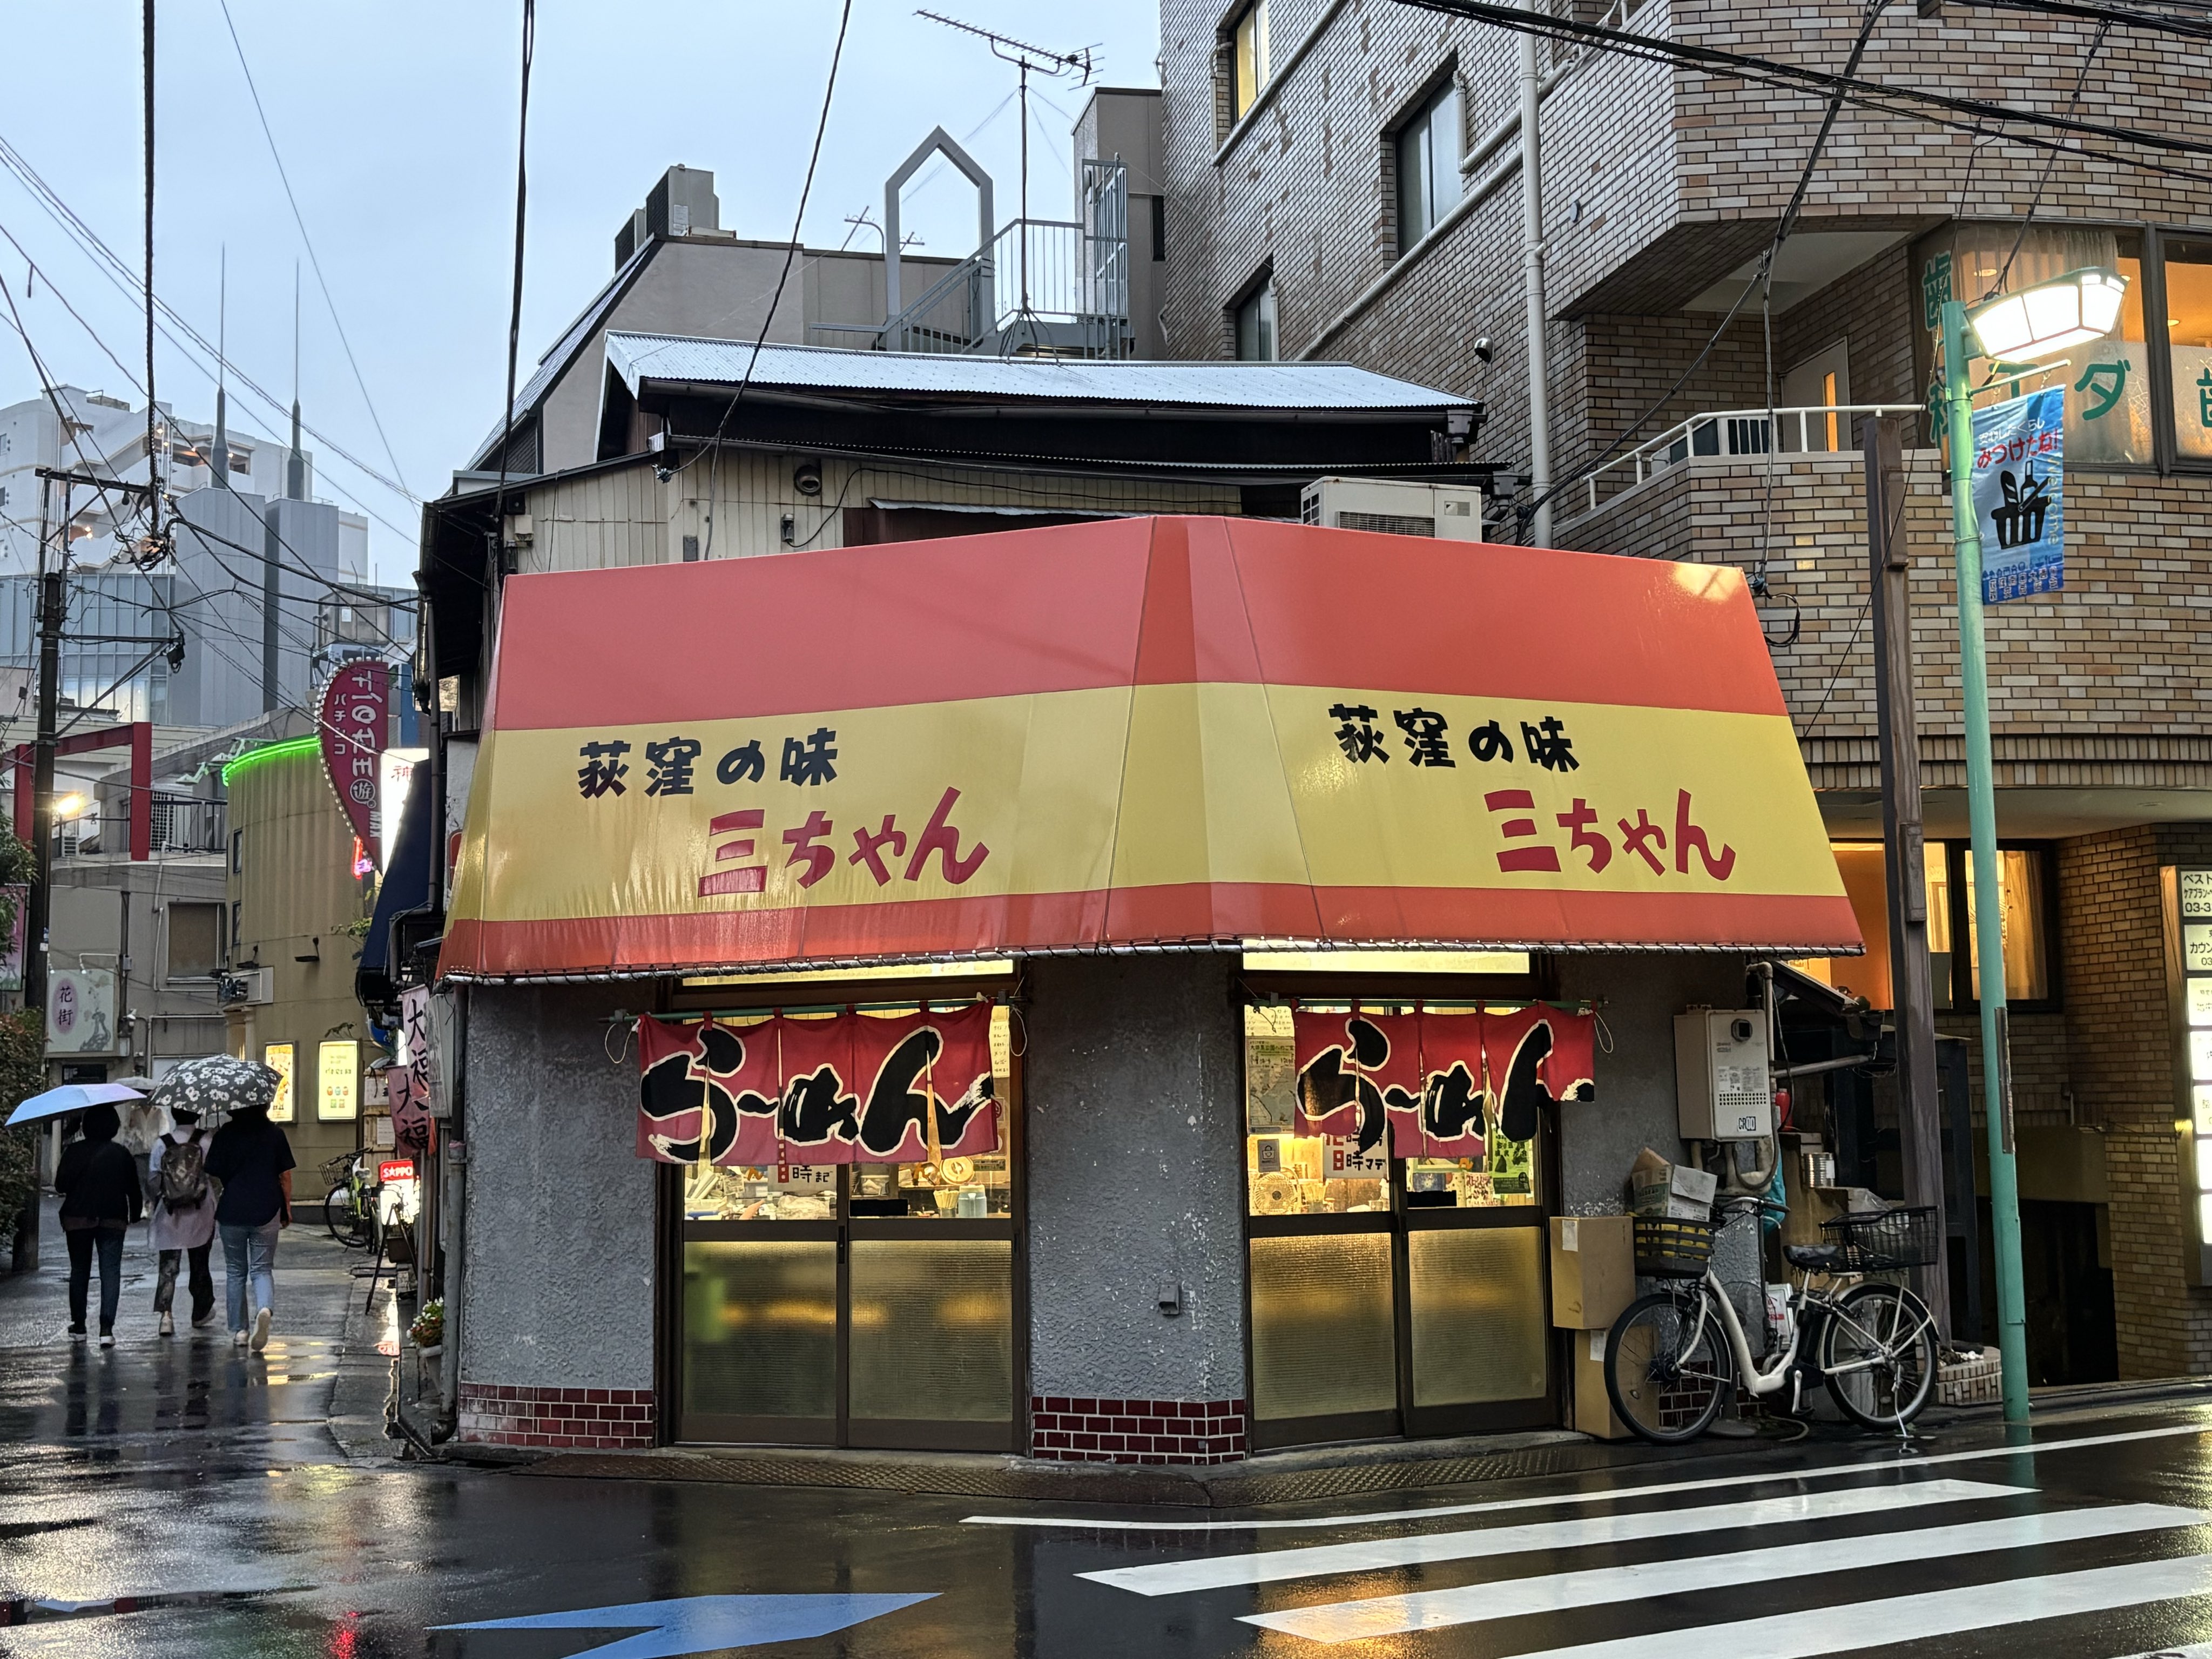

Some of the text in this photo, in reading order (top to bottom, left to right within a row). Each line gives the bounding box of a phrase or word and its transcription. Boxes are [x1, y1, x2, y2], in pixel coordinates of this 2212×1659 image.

[578, 727, 838, 799] 荻窪の味
[1328, 703, 1580, 773] 荻窪の味
[698, 787, 990, 896] 三ちゃん
[1484, 788, 1736, 881] 三ちゃん
[2185, 902, 2212, 912] 03-3
[58, 986, 73, 1025] 花街
[640, 1024, 993, 1164] らーめん
